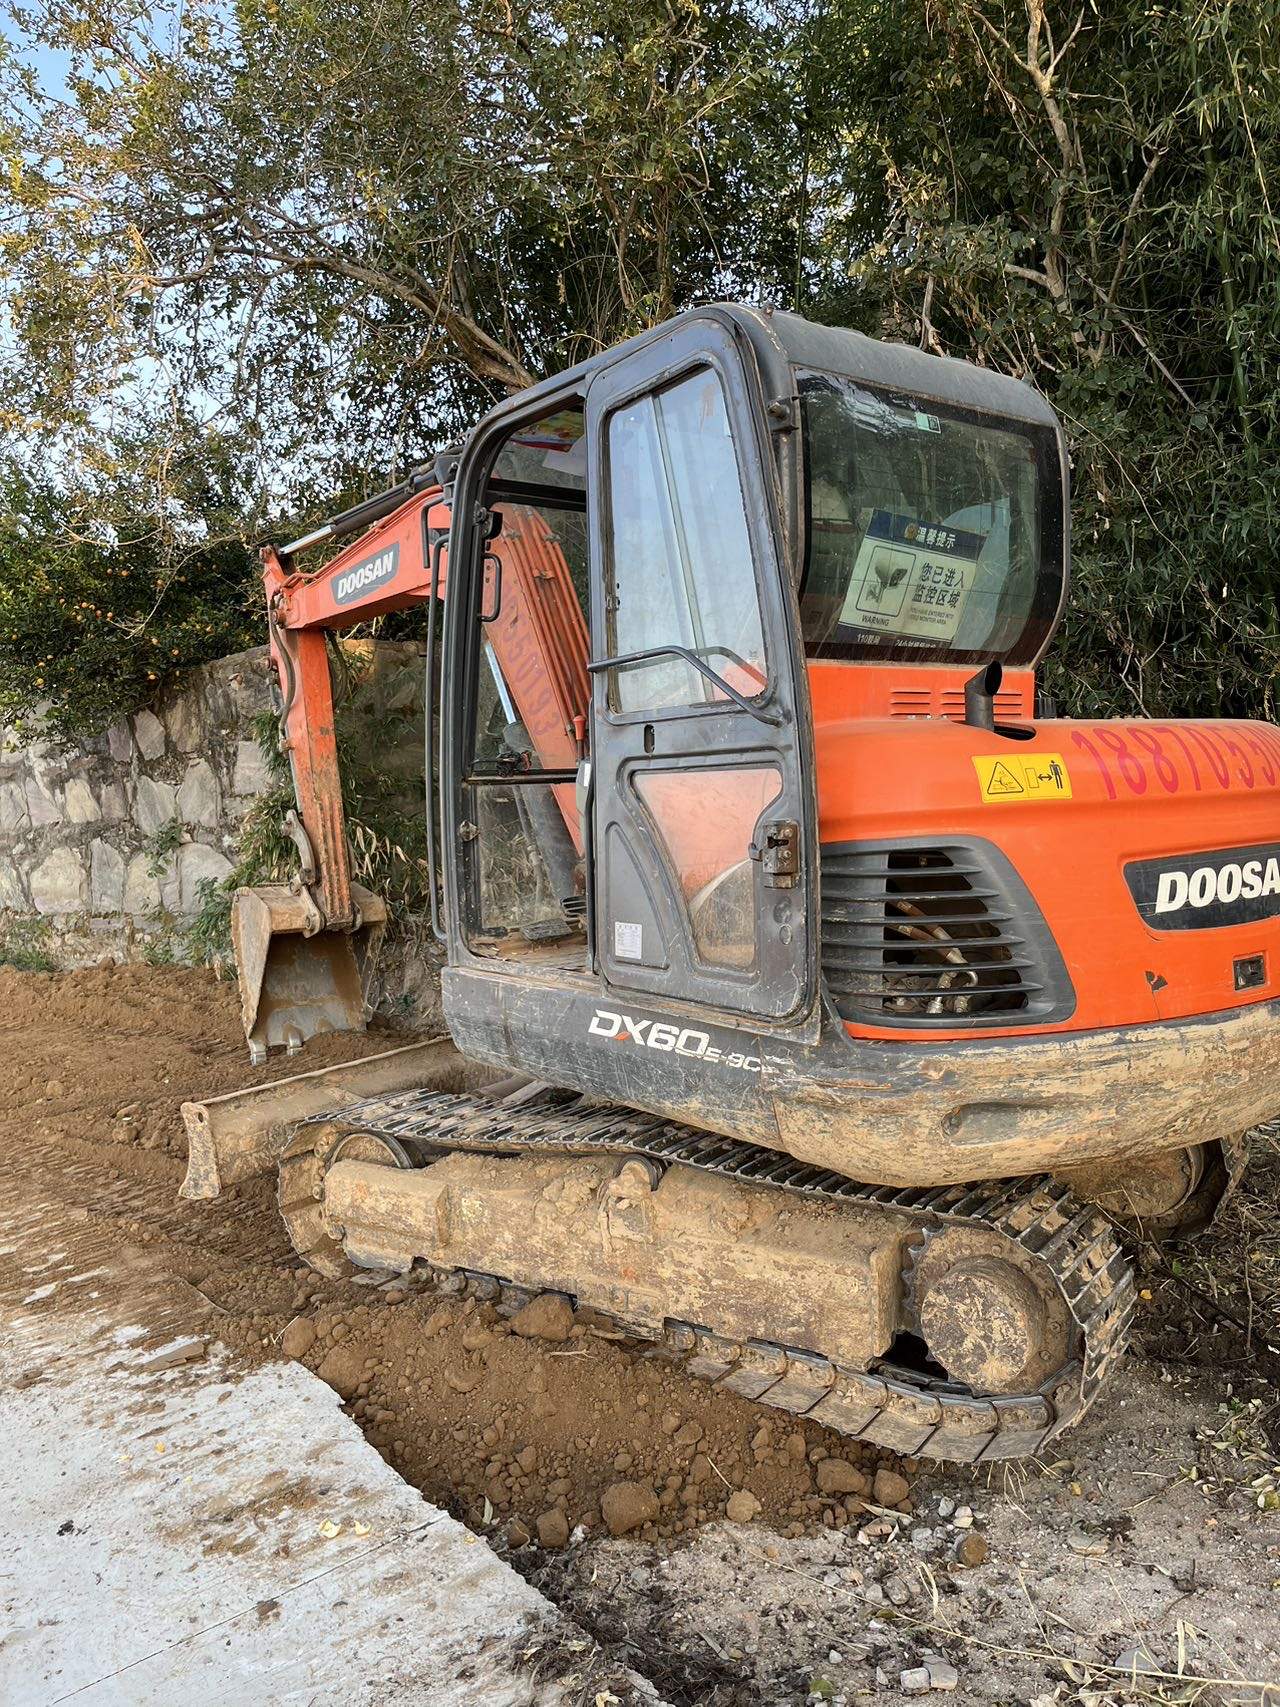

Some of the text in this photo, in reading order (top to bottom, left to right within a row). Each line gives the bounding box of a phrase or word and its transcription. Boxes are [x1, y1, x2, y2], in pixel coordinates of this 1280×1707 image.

[915, 526, 956, 549] 温馨提示
[337, 551, 394, 599] DOOSAN
[921, 562, 965, 588] 您已进入
[912, 583, 961, 608] 监控区域
[861, 614, 890, 627] WARNING
